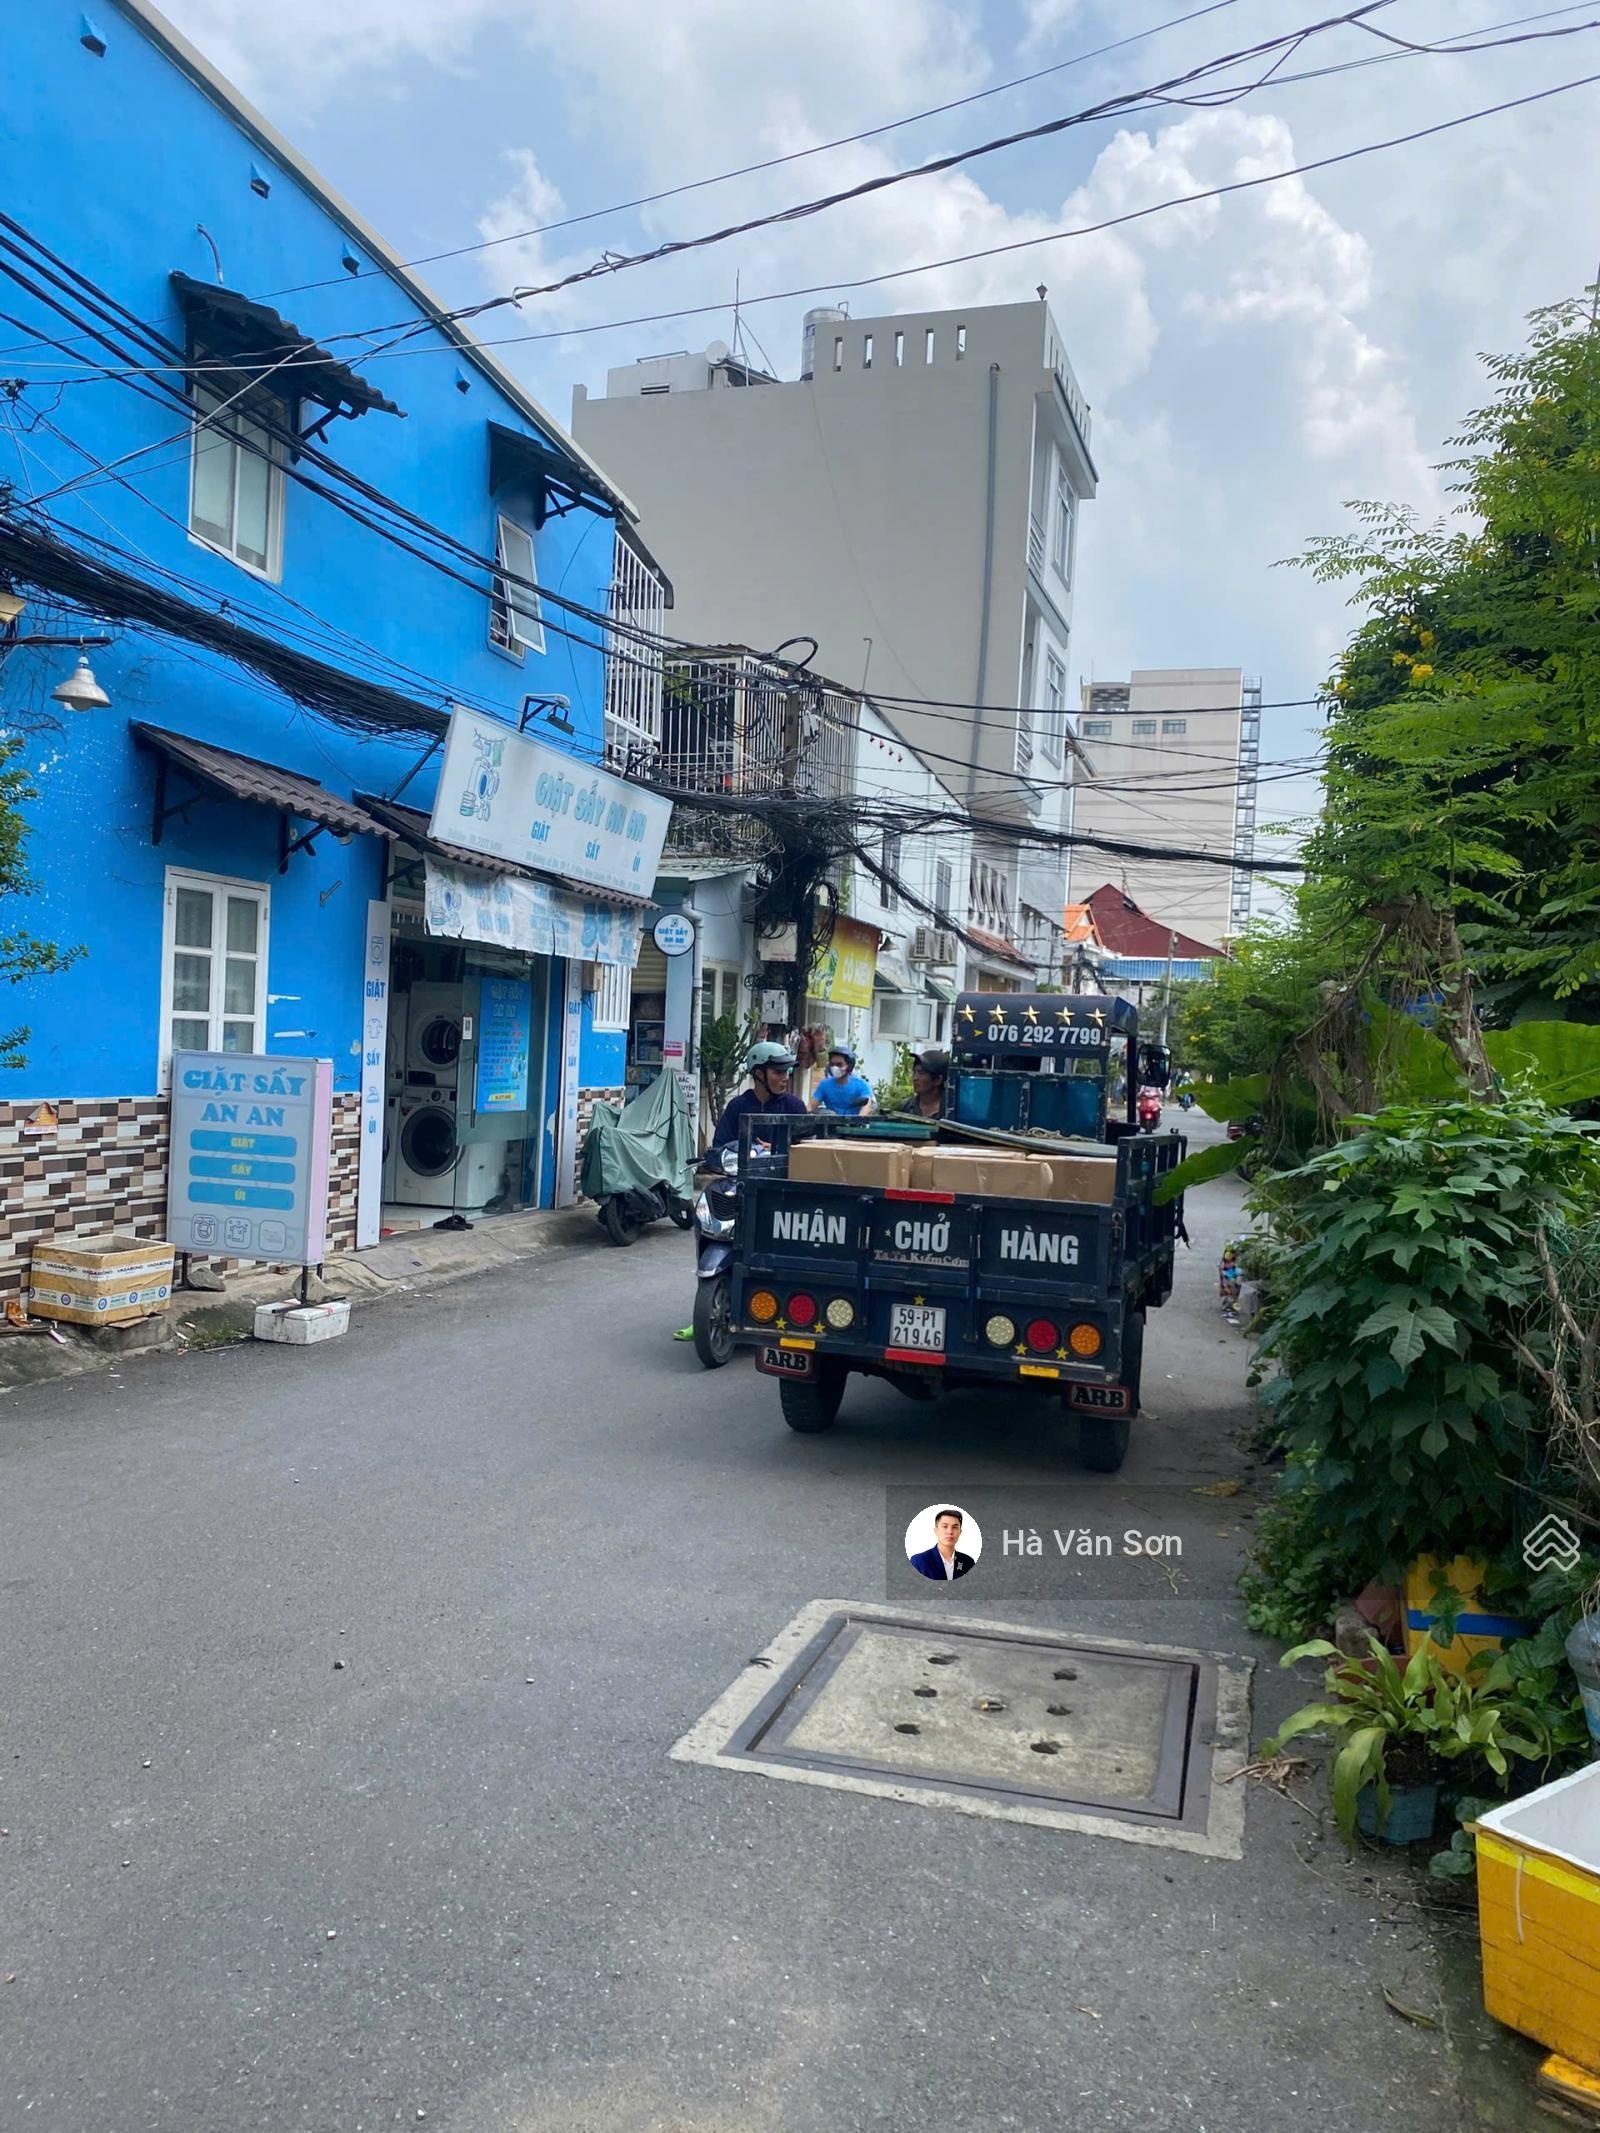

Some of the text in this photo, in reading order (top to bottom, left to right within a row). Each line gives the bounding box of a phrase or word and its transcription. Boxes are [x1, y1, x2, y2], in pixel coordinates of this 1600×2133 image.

[535, 770, 575, 818] GIẶT
[605, 801, 627, 836] AN
[626, 809, 647, 842] AN
[531, 820, 551, 845] GIẶT
[366, 978, 386, 1001] GIẶT
[988, 1024, 1101, 1046] 076 292 7799
[366, 1048, 381, 1066] SẤY
[183, 1065, 307, 1097] GIẶT SẤY
[200, 1102, 286, 1127] AN AN
[772, 1208, 1079, 1265] NHẬN CHỞ HÀNG
[899, 1308, 936, 1328] 59-P1
[894, 1326, 942, 1347] 219.46
[765, 1348, 807, 1371] ARB
[1073, 1386, 1124, 1408] ARB
